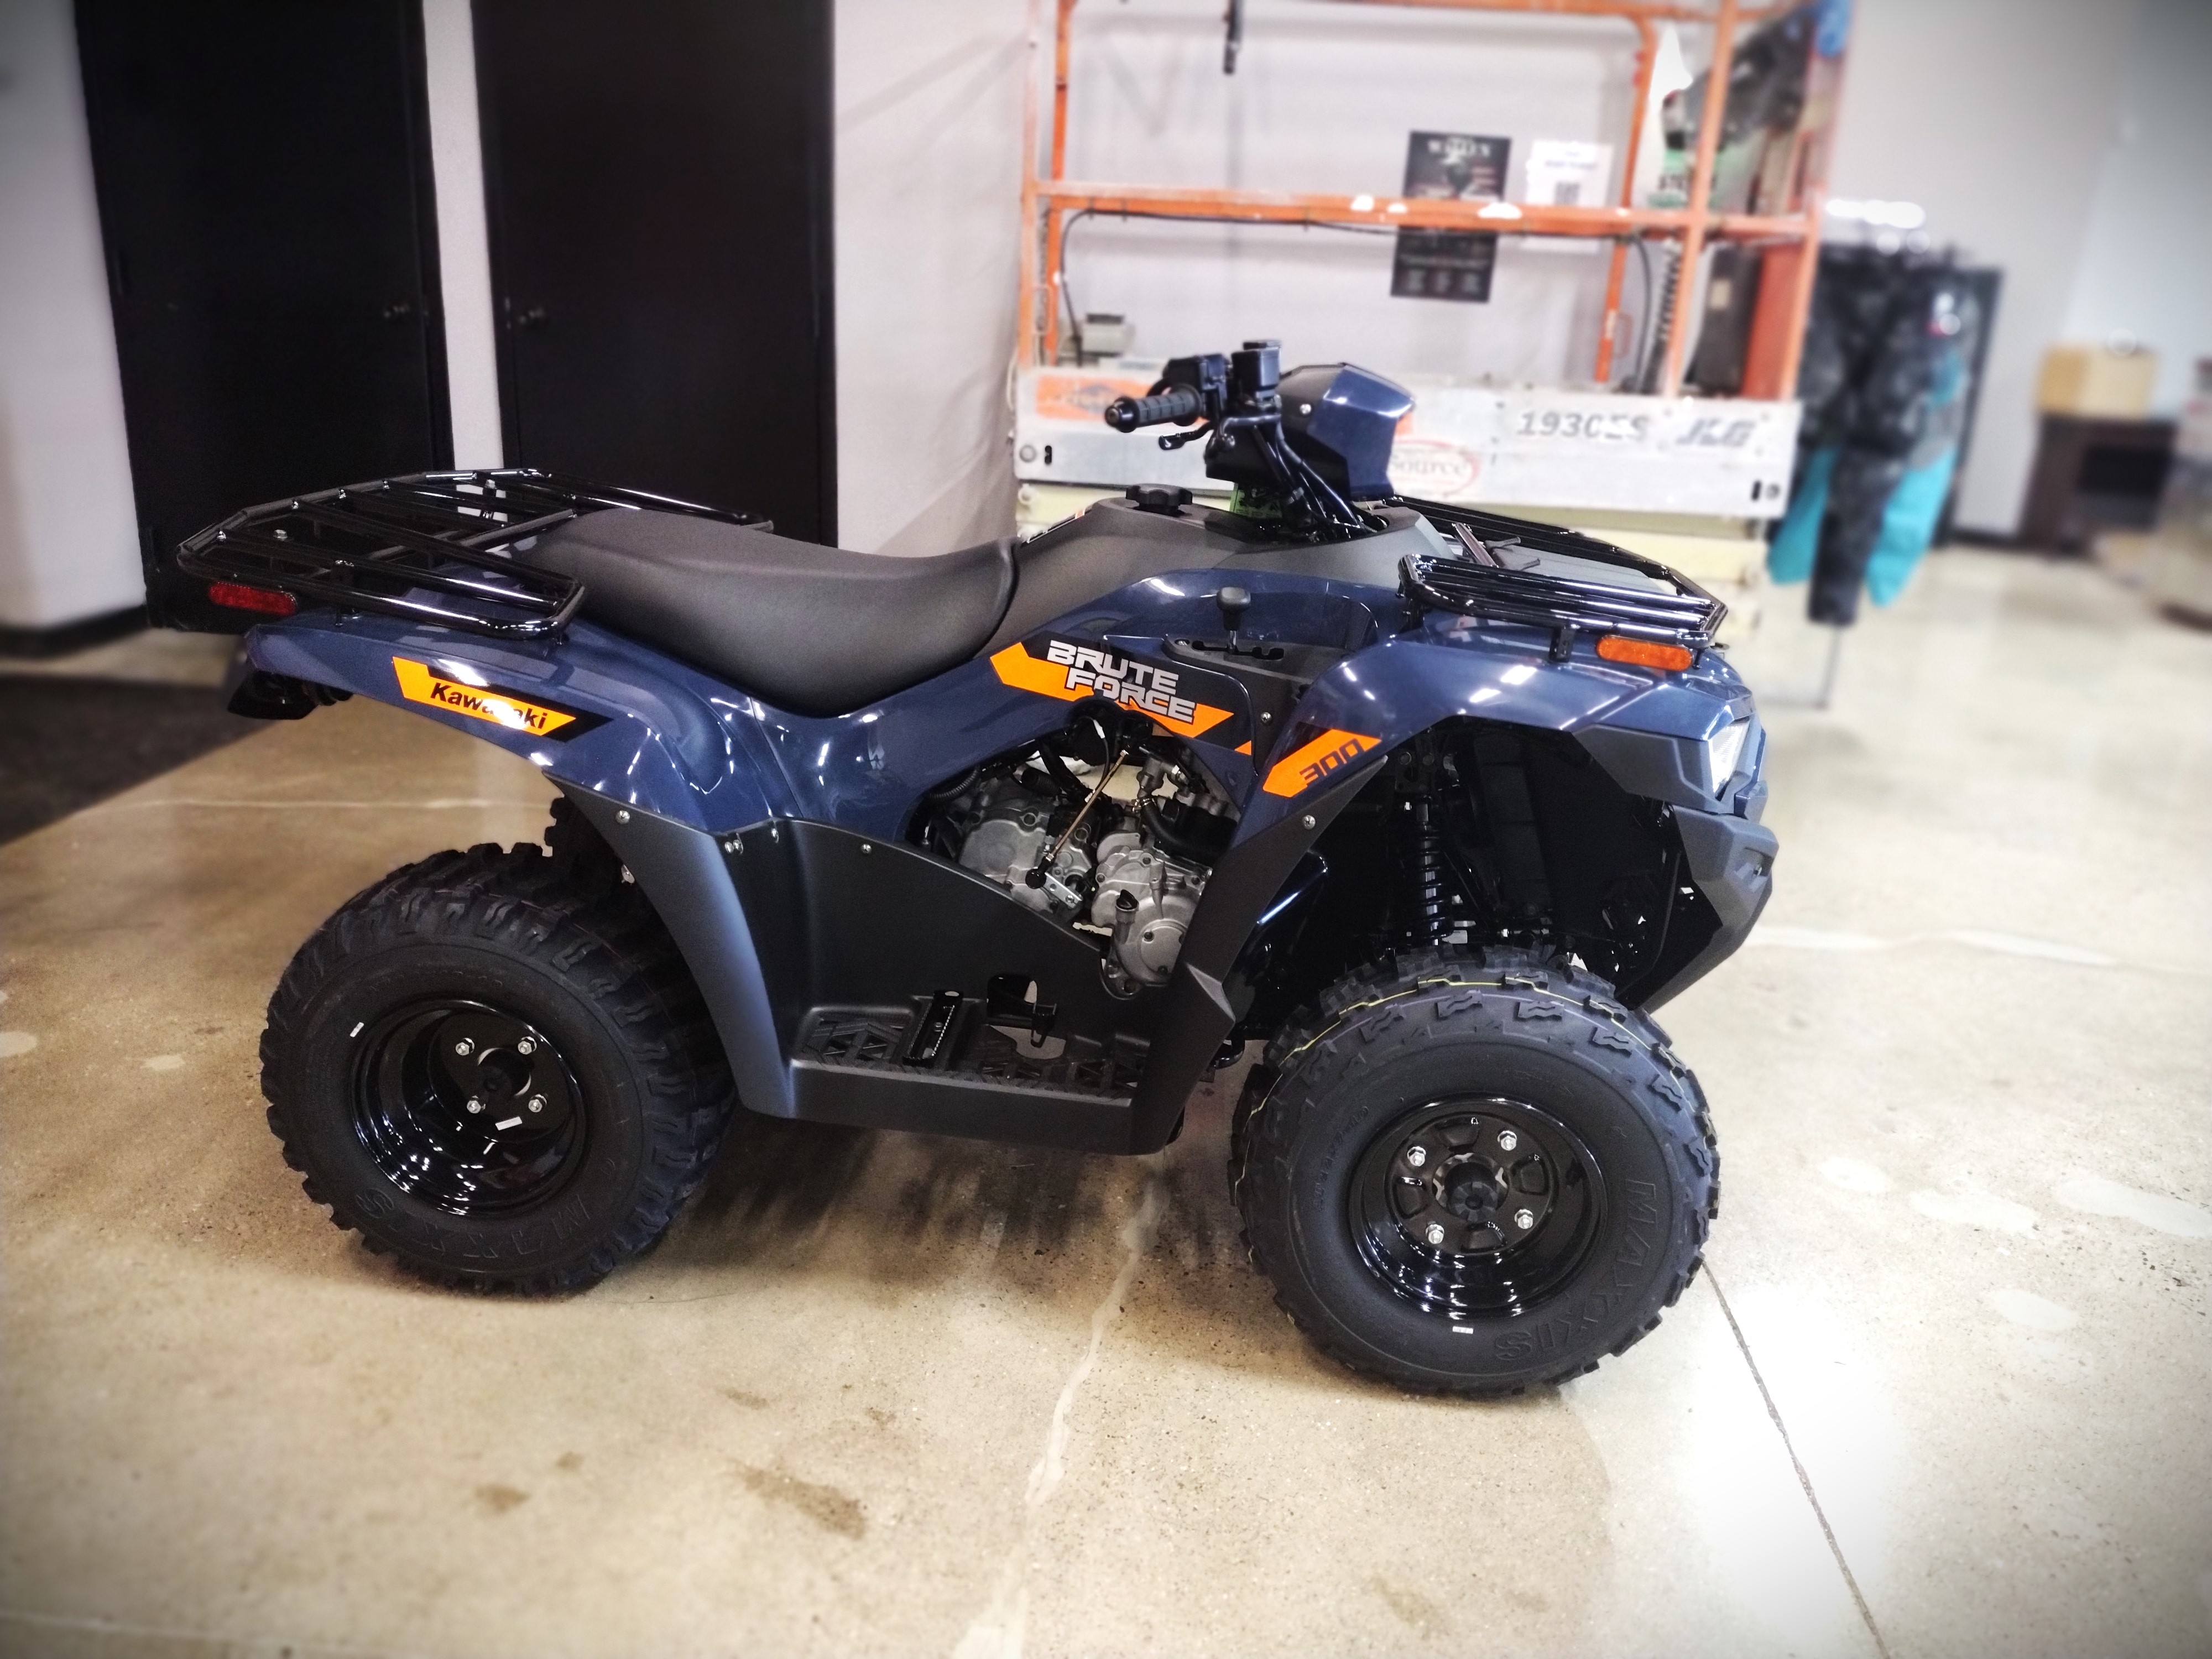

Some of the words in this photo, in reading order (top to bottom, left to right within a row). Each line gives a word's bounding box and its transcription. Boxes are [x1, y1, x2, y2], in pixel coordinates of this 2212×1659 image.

[1046, 640, 1179, 695] BRUTE
[1066, 667, 1196, 723] FORCE
[430, 682, 548, 729] Kawki
[1299, 738, 1365, 785] 300
[1494, 1179, 1658, 1360] MAXXIS
